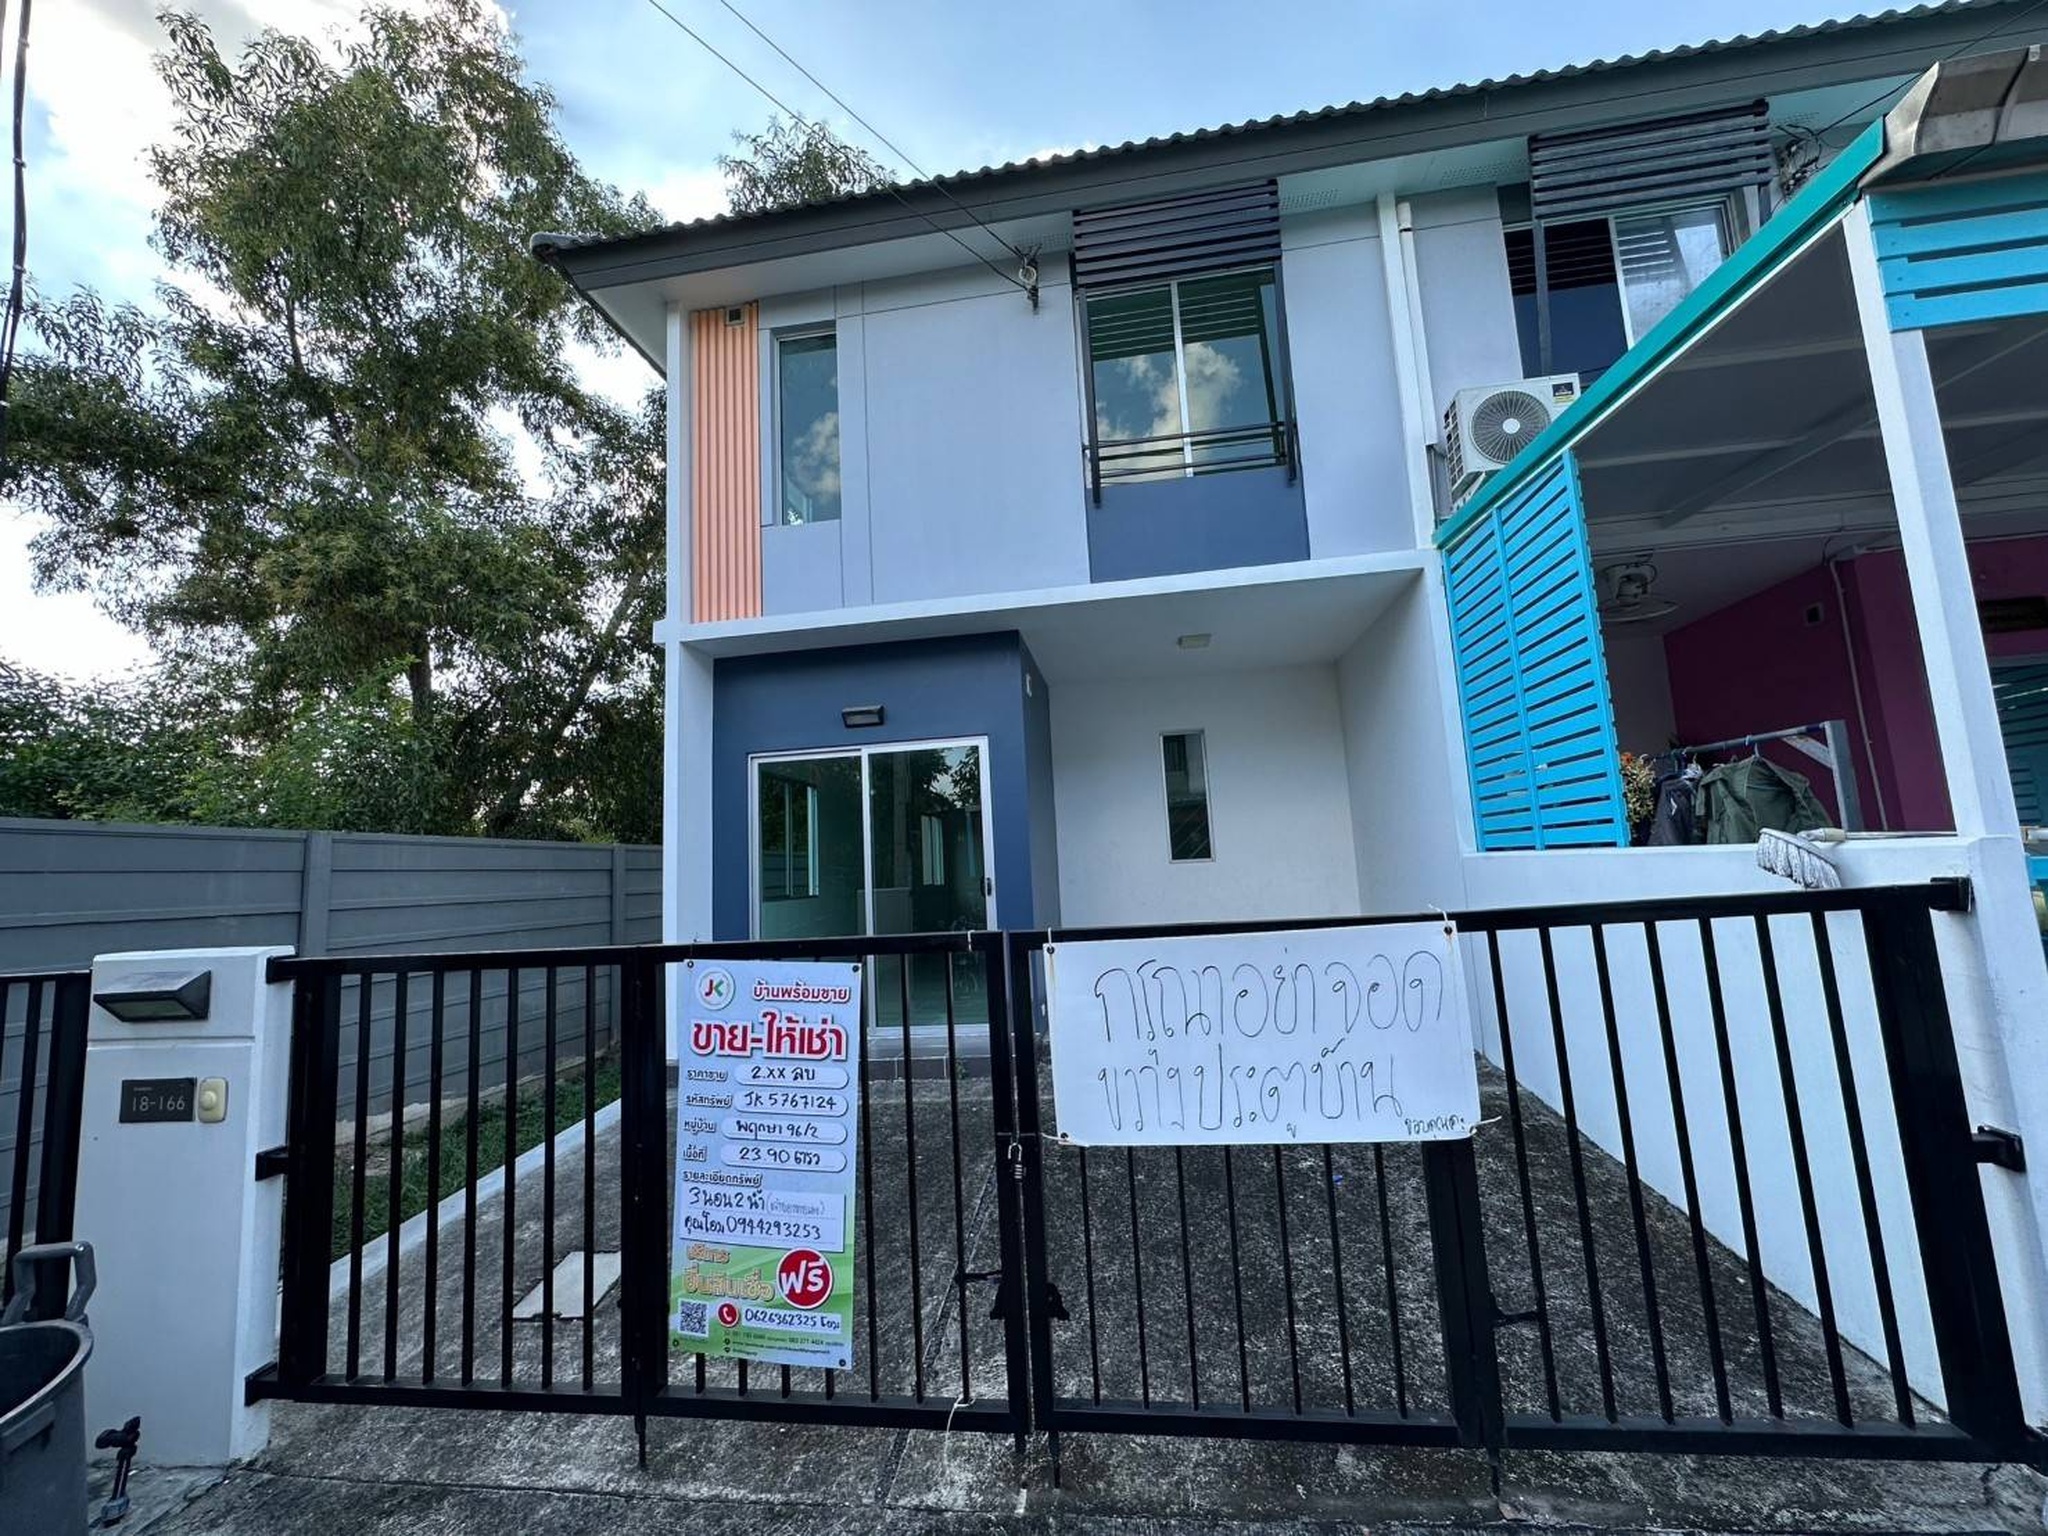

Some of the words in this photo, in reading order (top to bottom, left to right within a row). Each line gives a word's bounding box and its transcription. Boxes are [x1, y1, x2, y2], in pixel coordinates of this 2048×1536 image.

[705, 979, 724, 997] JK
[753, 980, 849, 1000] บ้านพร้อมขาย
[693, 1011, 843, 1056] ขาย-ให้เช่า
[687, 1069, 726, 1080] ราคาขาย
[133, 1096, 185, 1111] 18-166
[686, 1093, 731, 1106] รหัสทรัพย์
[684, 1118, 714, 1133] หมู่บ้าน
[683, 1170, 761, 1185] รายละเอียดทรัพย์
[781, 1257, 825, 1294] ฟรี
